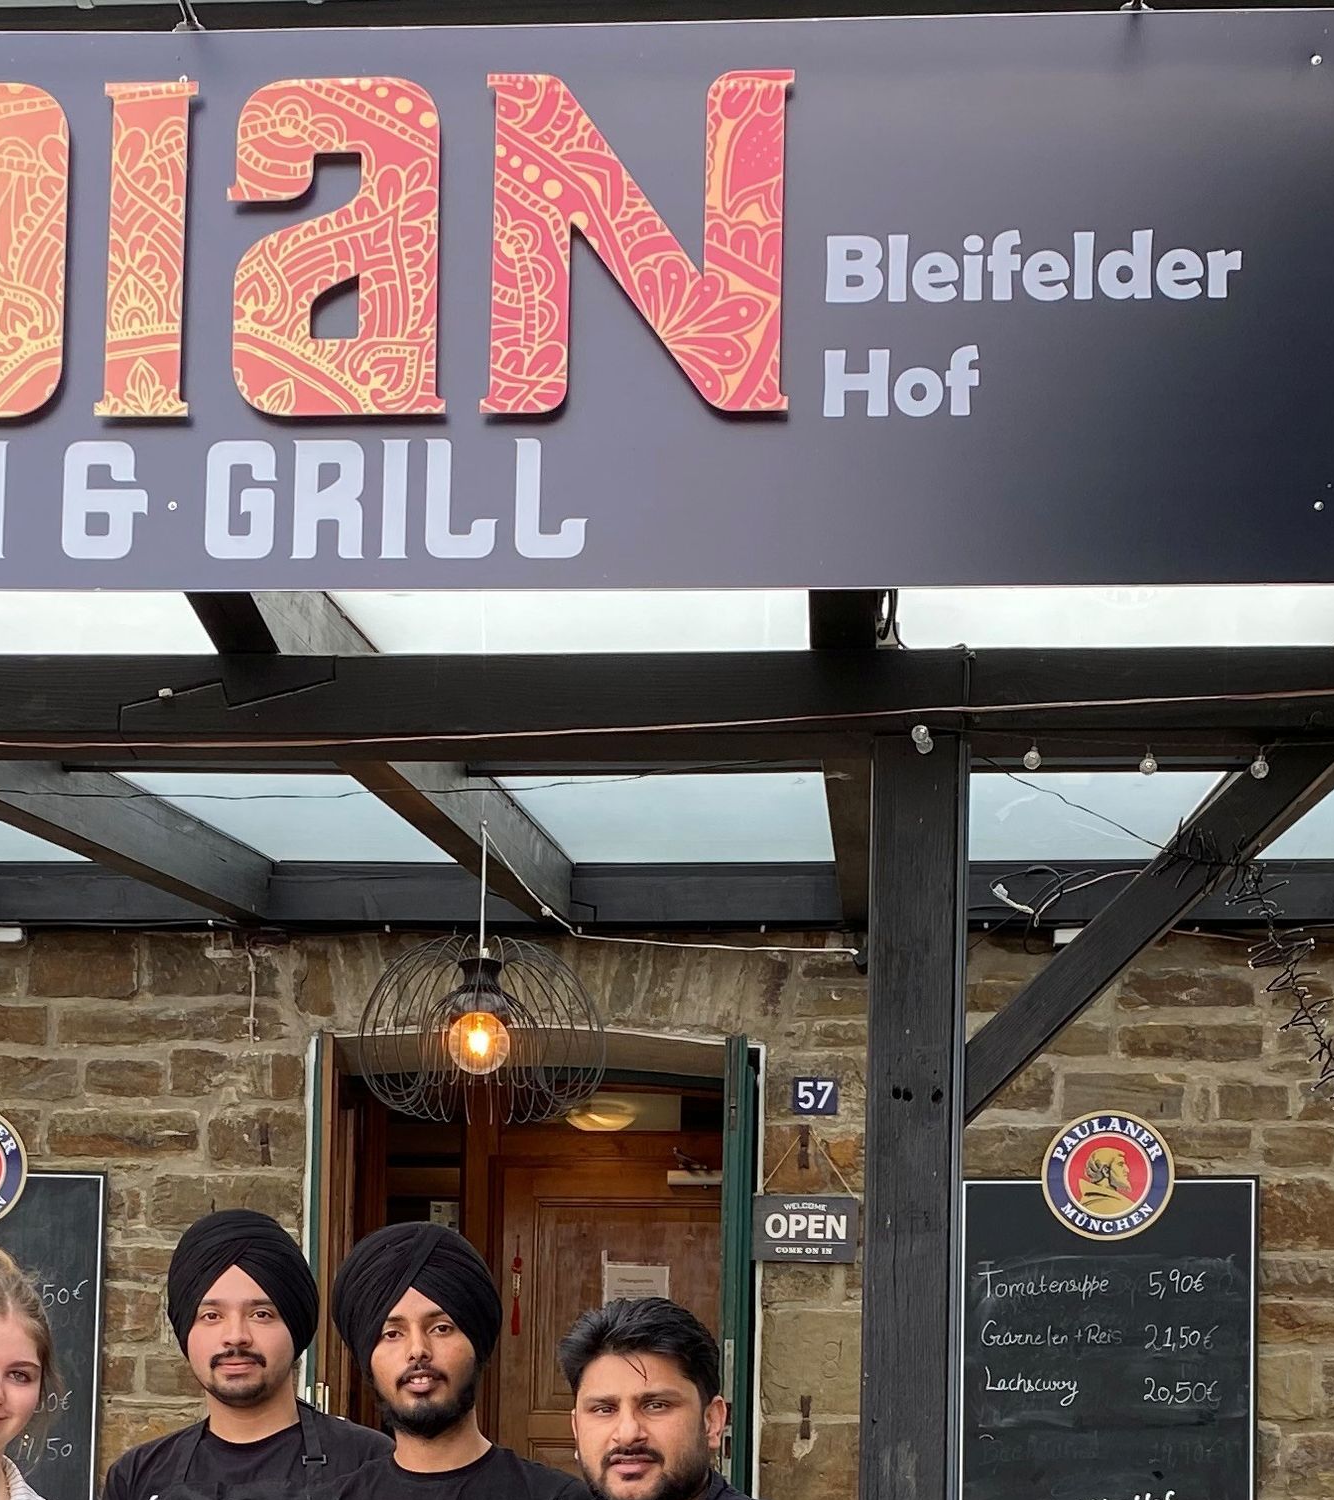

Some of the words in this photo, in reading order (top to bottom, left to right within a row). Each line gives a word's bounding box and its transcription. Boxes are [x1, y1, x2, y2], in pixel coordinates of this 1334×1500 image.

[825, 229, 1243, 303] Bleifelder
[823, 344, 980, 417] Hof
[61, 440, 148, 559] &
[204, 438, 588, 559] GRILL
[797, 1081, 834, 1110] 57
[1052, 1117, 1164, 1162] PAULANER
[783, 1202, 828, 1211] WELCOME
[1060, 1202, 1154, 1233] MÜNCHEN
[765, 1213, 847, 1240] OPEN
[775, 1246, 803, 1254] COME
[804, 1247, 819, 1255] ON
[821, 1247, 833, 1255] IN
[42, 1279, 89, 1308] 50€
[1148, 1269, 1206, 1300] 5,90€
